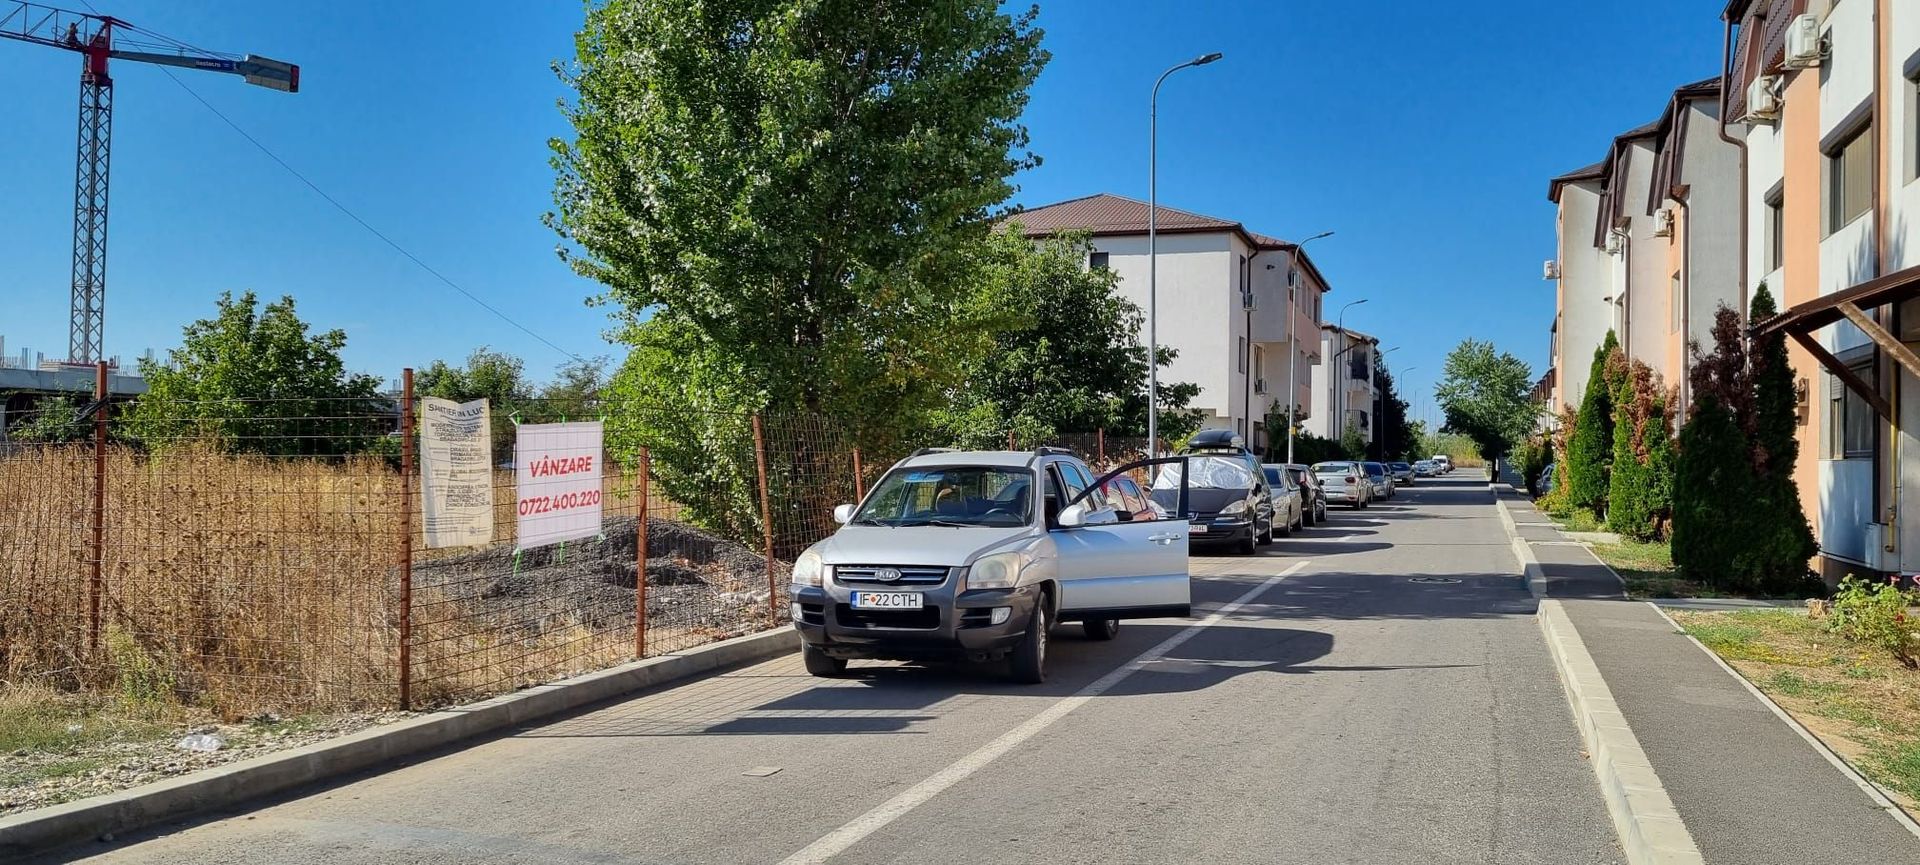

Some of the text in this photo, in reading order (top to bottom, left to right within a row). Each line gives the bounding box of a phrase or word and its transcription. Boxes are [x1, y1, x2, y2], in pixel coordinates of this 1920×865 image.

[530, 455, 593, 478] VÂNZARE
[519, 490, 601, 516] 0722.400.220
[875, 593, 889, 606] 22
[892, 594, 918, 607] CTH
